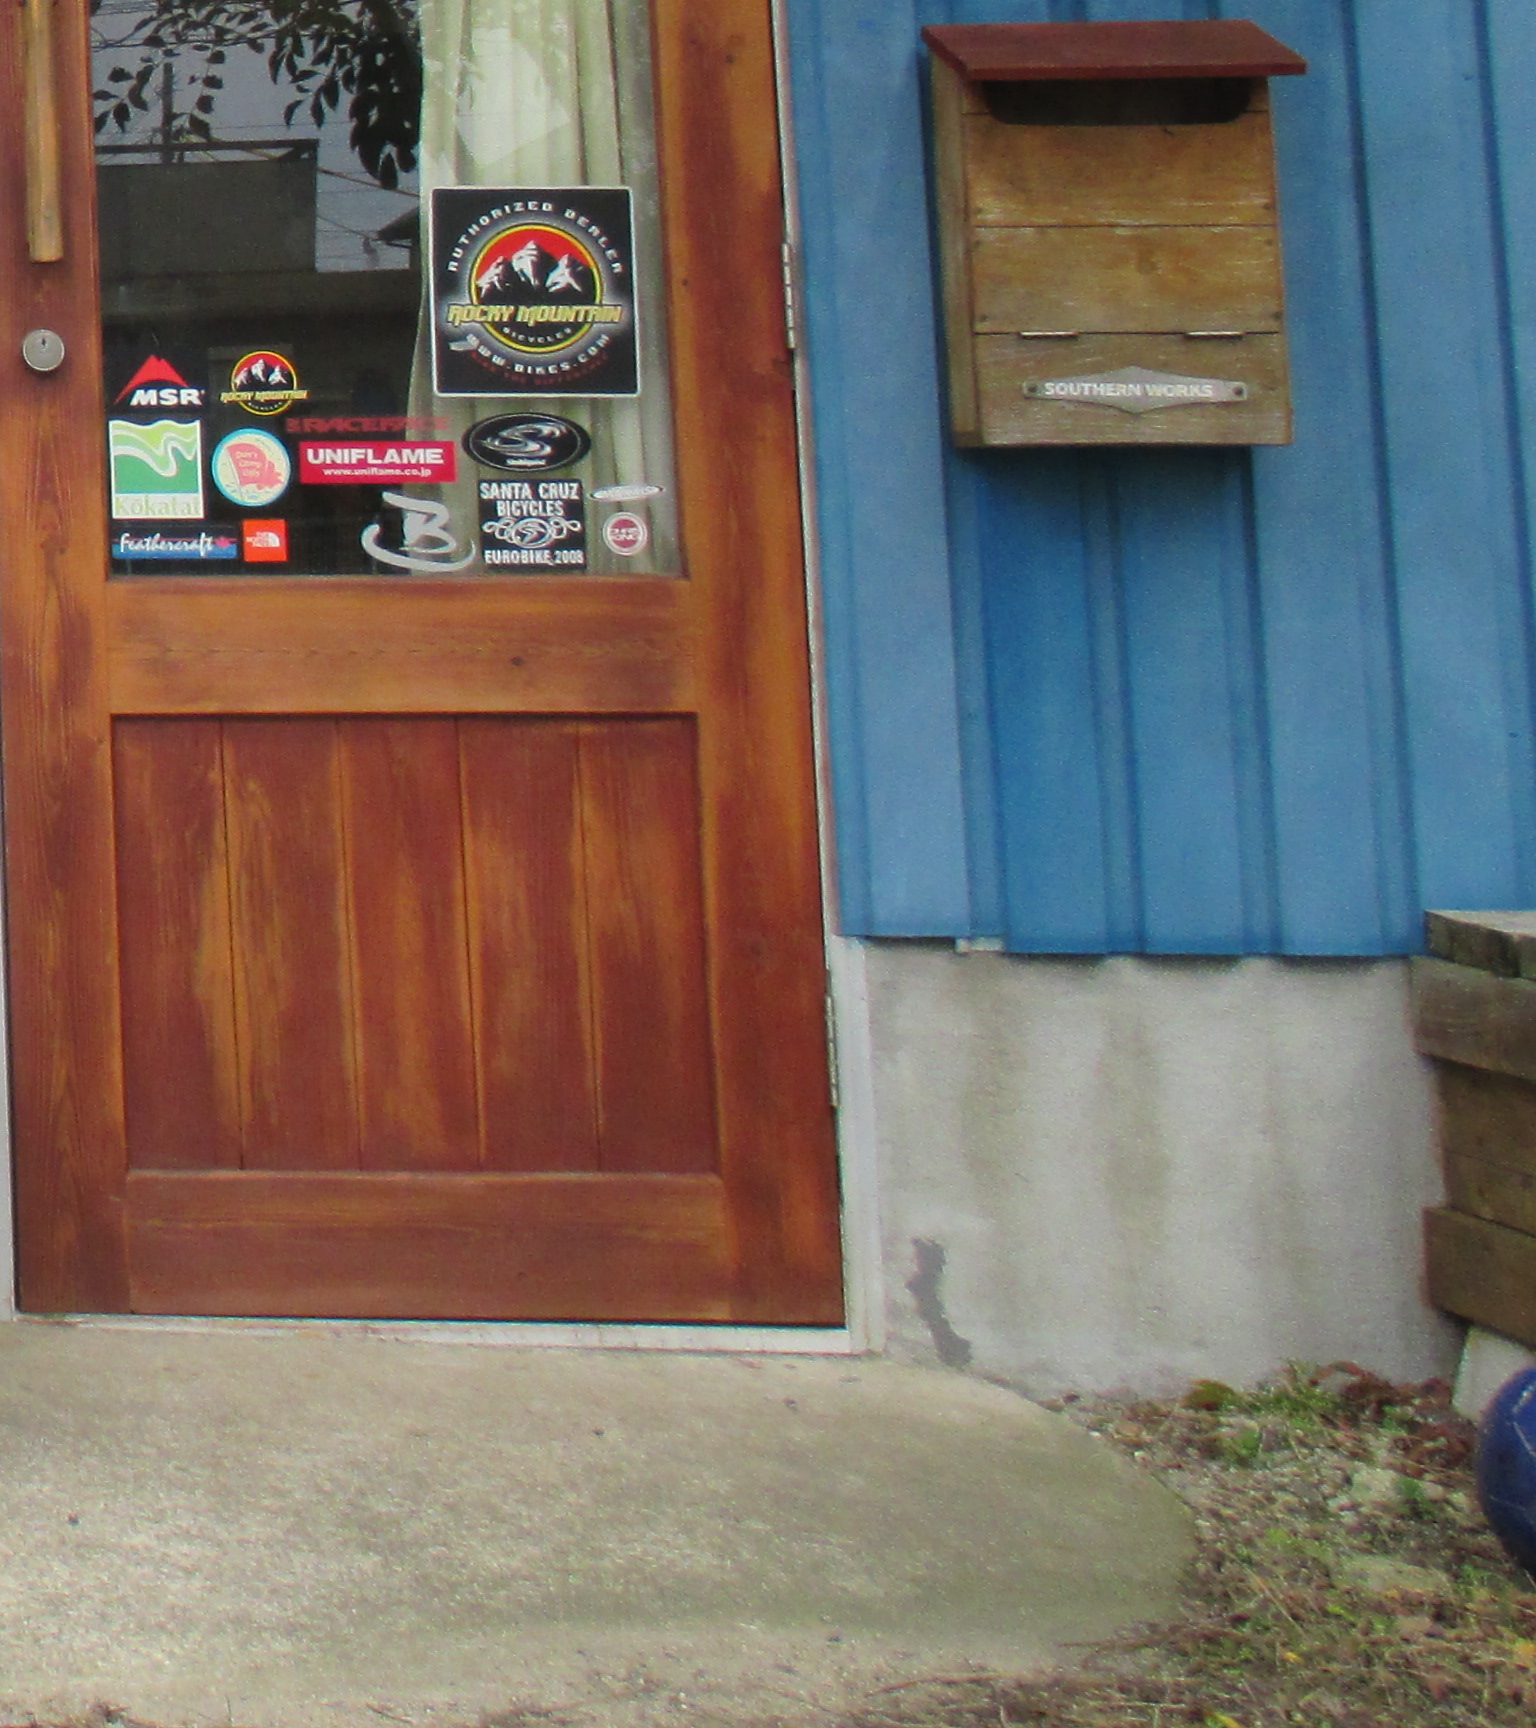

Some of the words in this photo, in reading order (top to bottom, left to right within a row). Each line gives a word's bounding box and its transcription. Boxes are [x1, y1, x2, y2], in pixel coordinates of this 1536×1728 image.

[447, 201, 554, 273] AUTHORIZED
[563, 208, 624, 273] DEALER
[447, 304, 514, 327] ROCKY
[516, 304, 622, 327] MOUNTAIN
[1044, 382, 1142, 397] SOUTHERN
[1146, 383, 1213, 398] WORKS
[306, 448, 444, 465] UNIFLAME
[322, 467, 432, 477] www.uniflame.co.jp
[479, 482, 533, 500] SANTA
[538, 481, 580, 500] CRUZ
[496, 499, 565, 517] BICYCLES
[119, 532, 214, 557] Feathercraft
[484, 548, 552, 566] EUROBIKE
